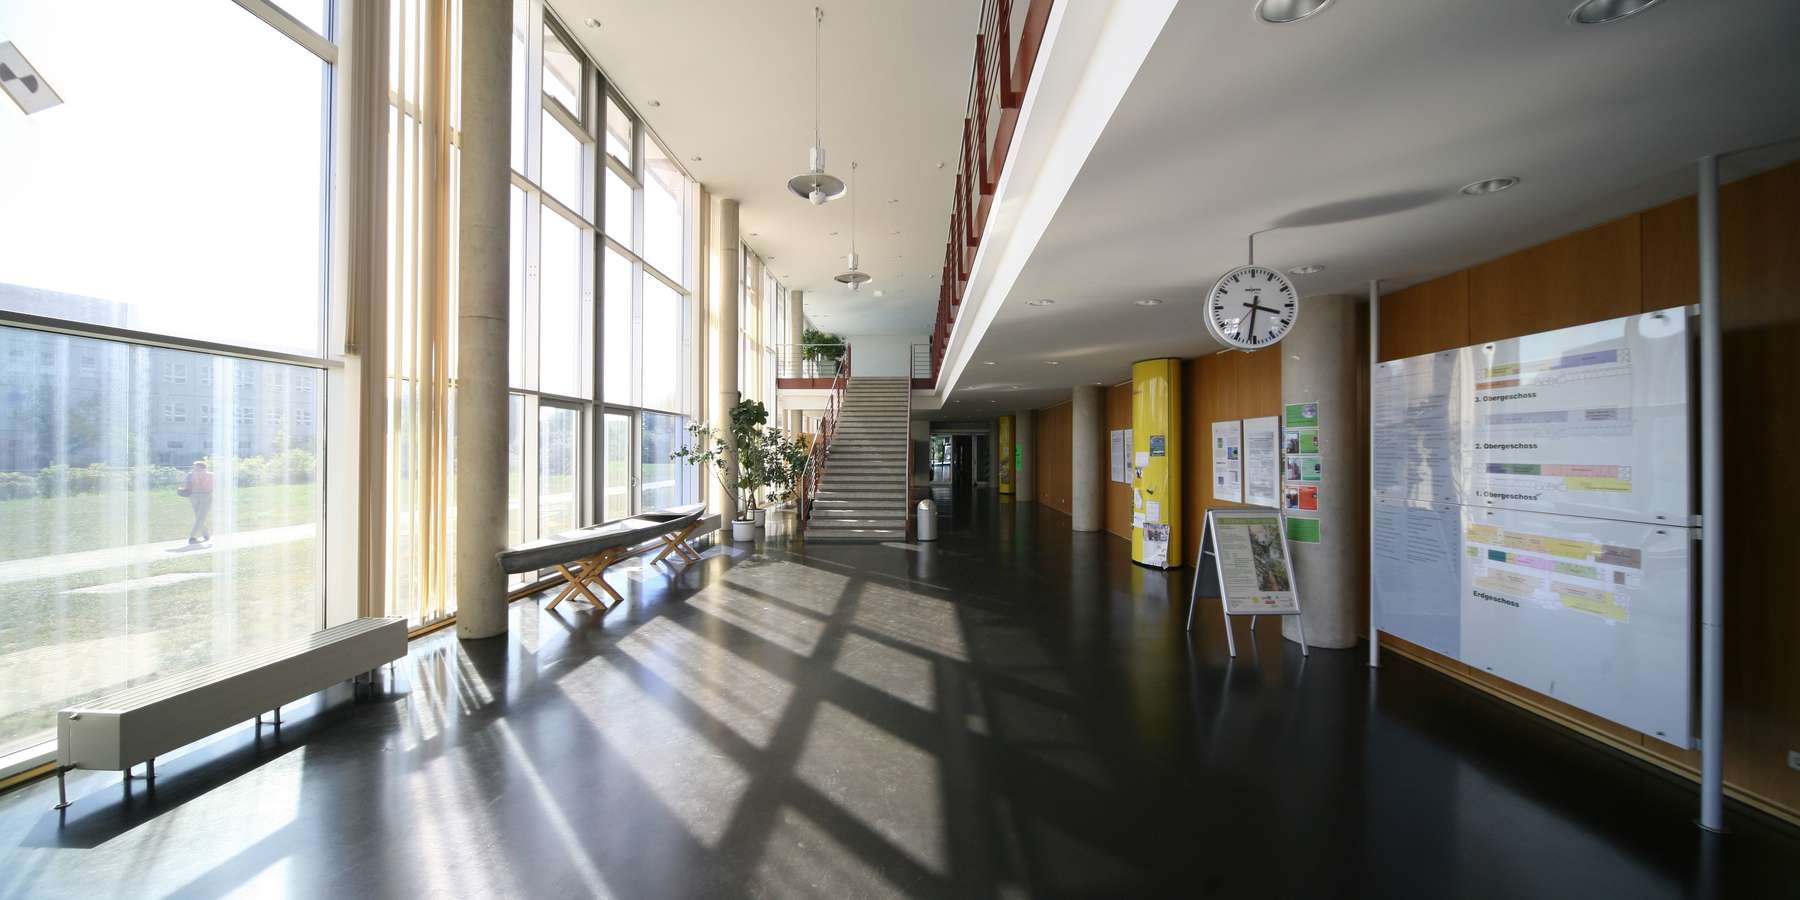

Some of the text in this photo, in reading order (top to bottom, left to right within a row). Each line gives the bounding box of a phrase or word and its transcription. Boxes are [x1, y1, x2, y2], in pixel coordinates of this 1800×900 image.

[1482, 392, 1537, 402] Obergeschoss
[1483, 442, 1538, 450] Obergeschoss
[1483, 491, 1538, 501] Obergeschoss
[1473, 590, 1520, 608] Erdgeschoss
